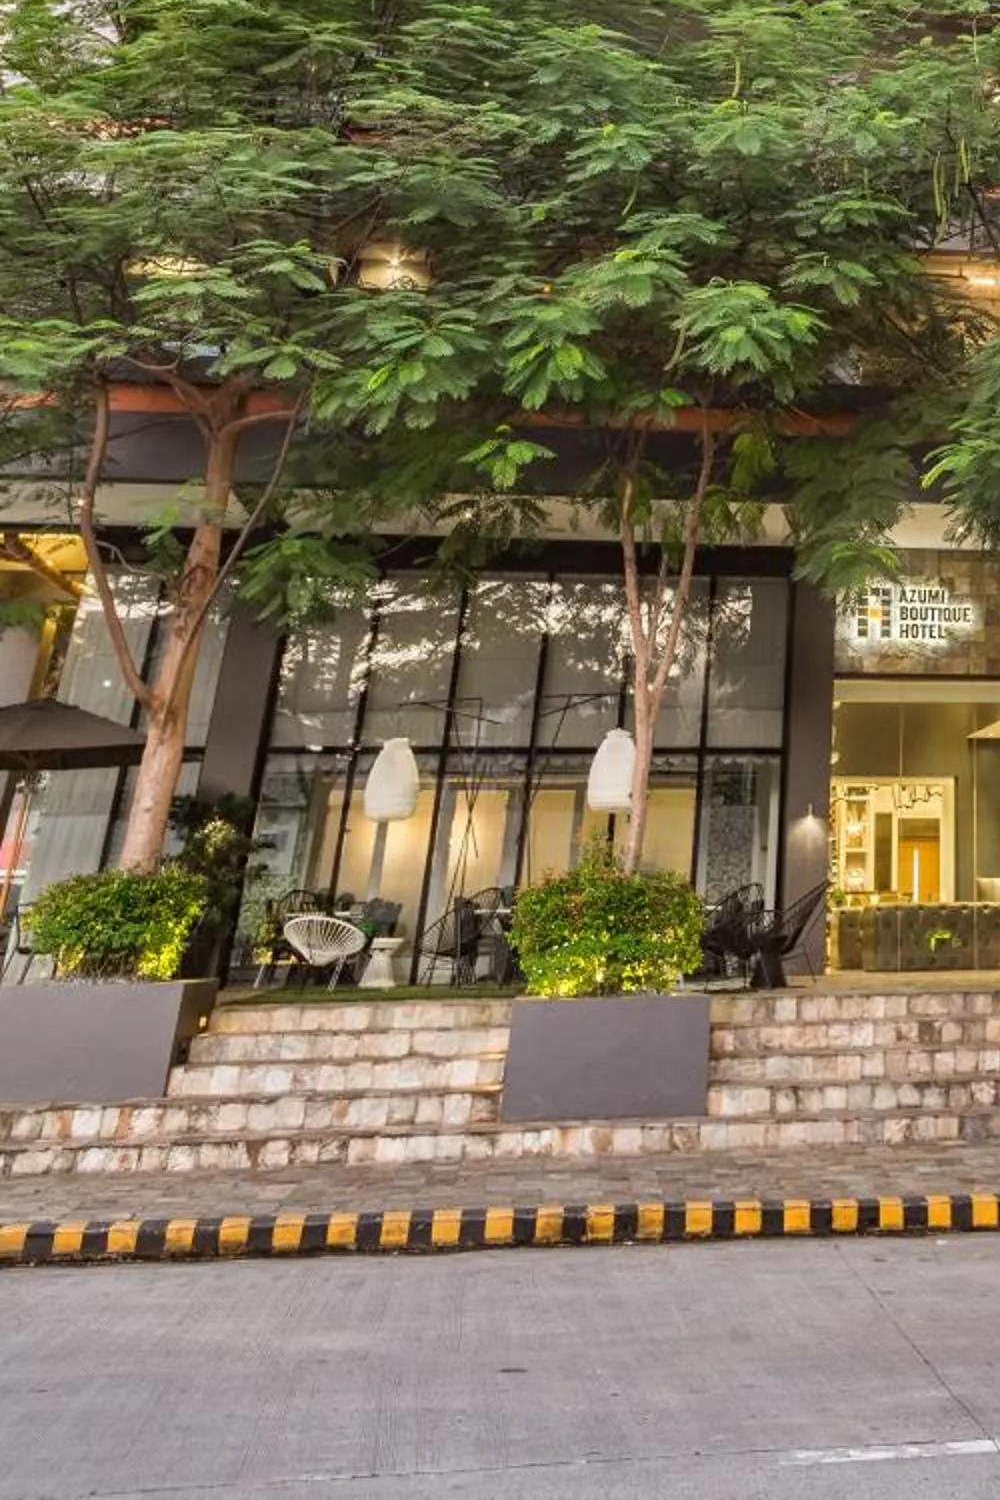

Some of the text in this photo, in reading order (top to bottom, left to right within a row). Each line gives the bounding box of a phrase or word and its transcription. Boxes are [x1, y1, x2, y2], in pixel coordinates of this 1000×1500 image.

[899, 588, 946, 603] AZUMI
[899, 606, 971, 622] BOUTIQUE
[899, 623, 945, 639] HOTEL
